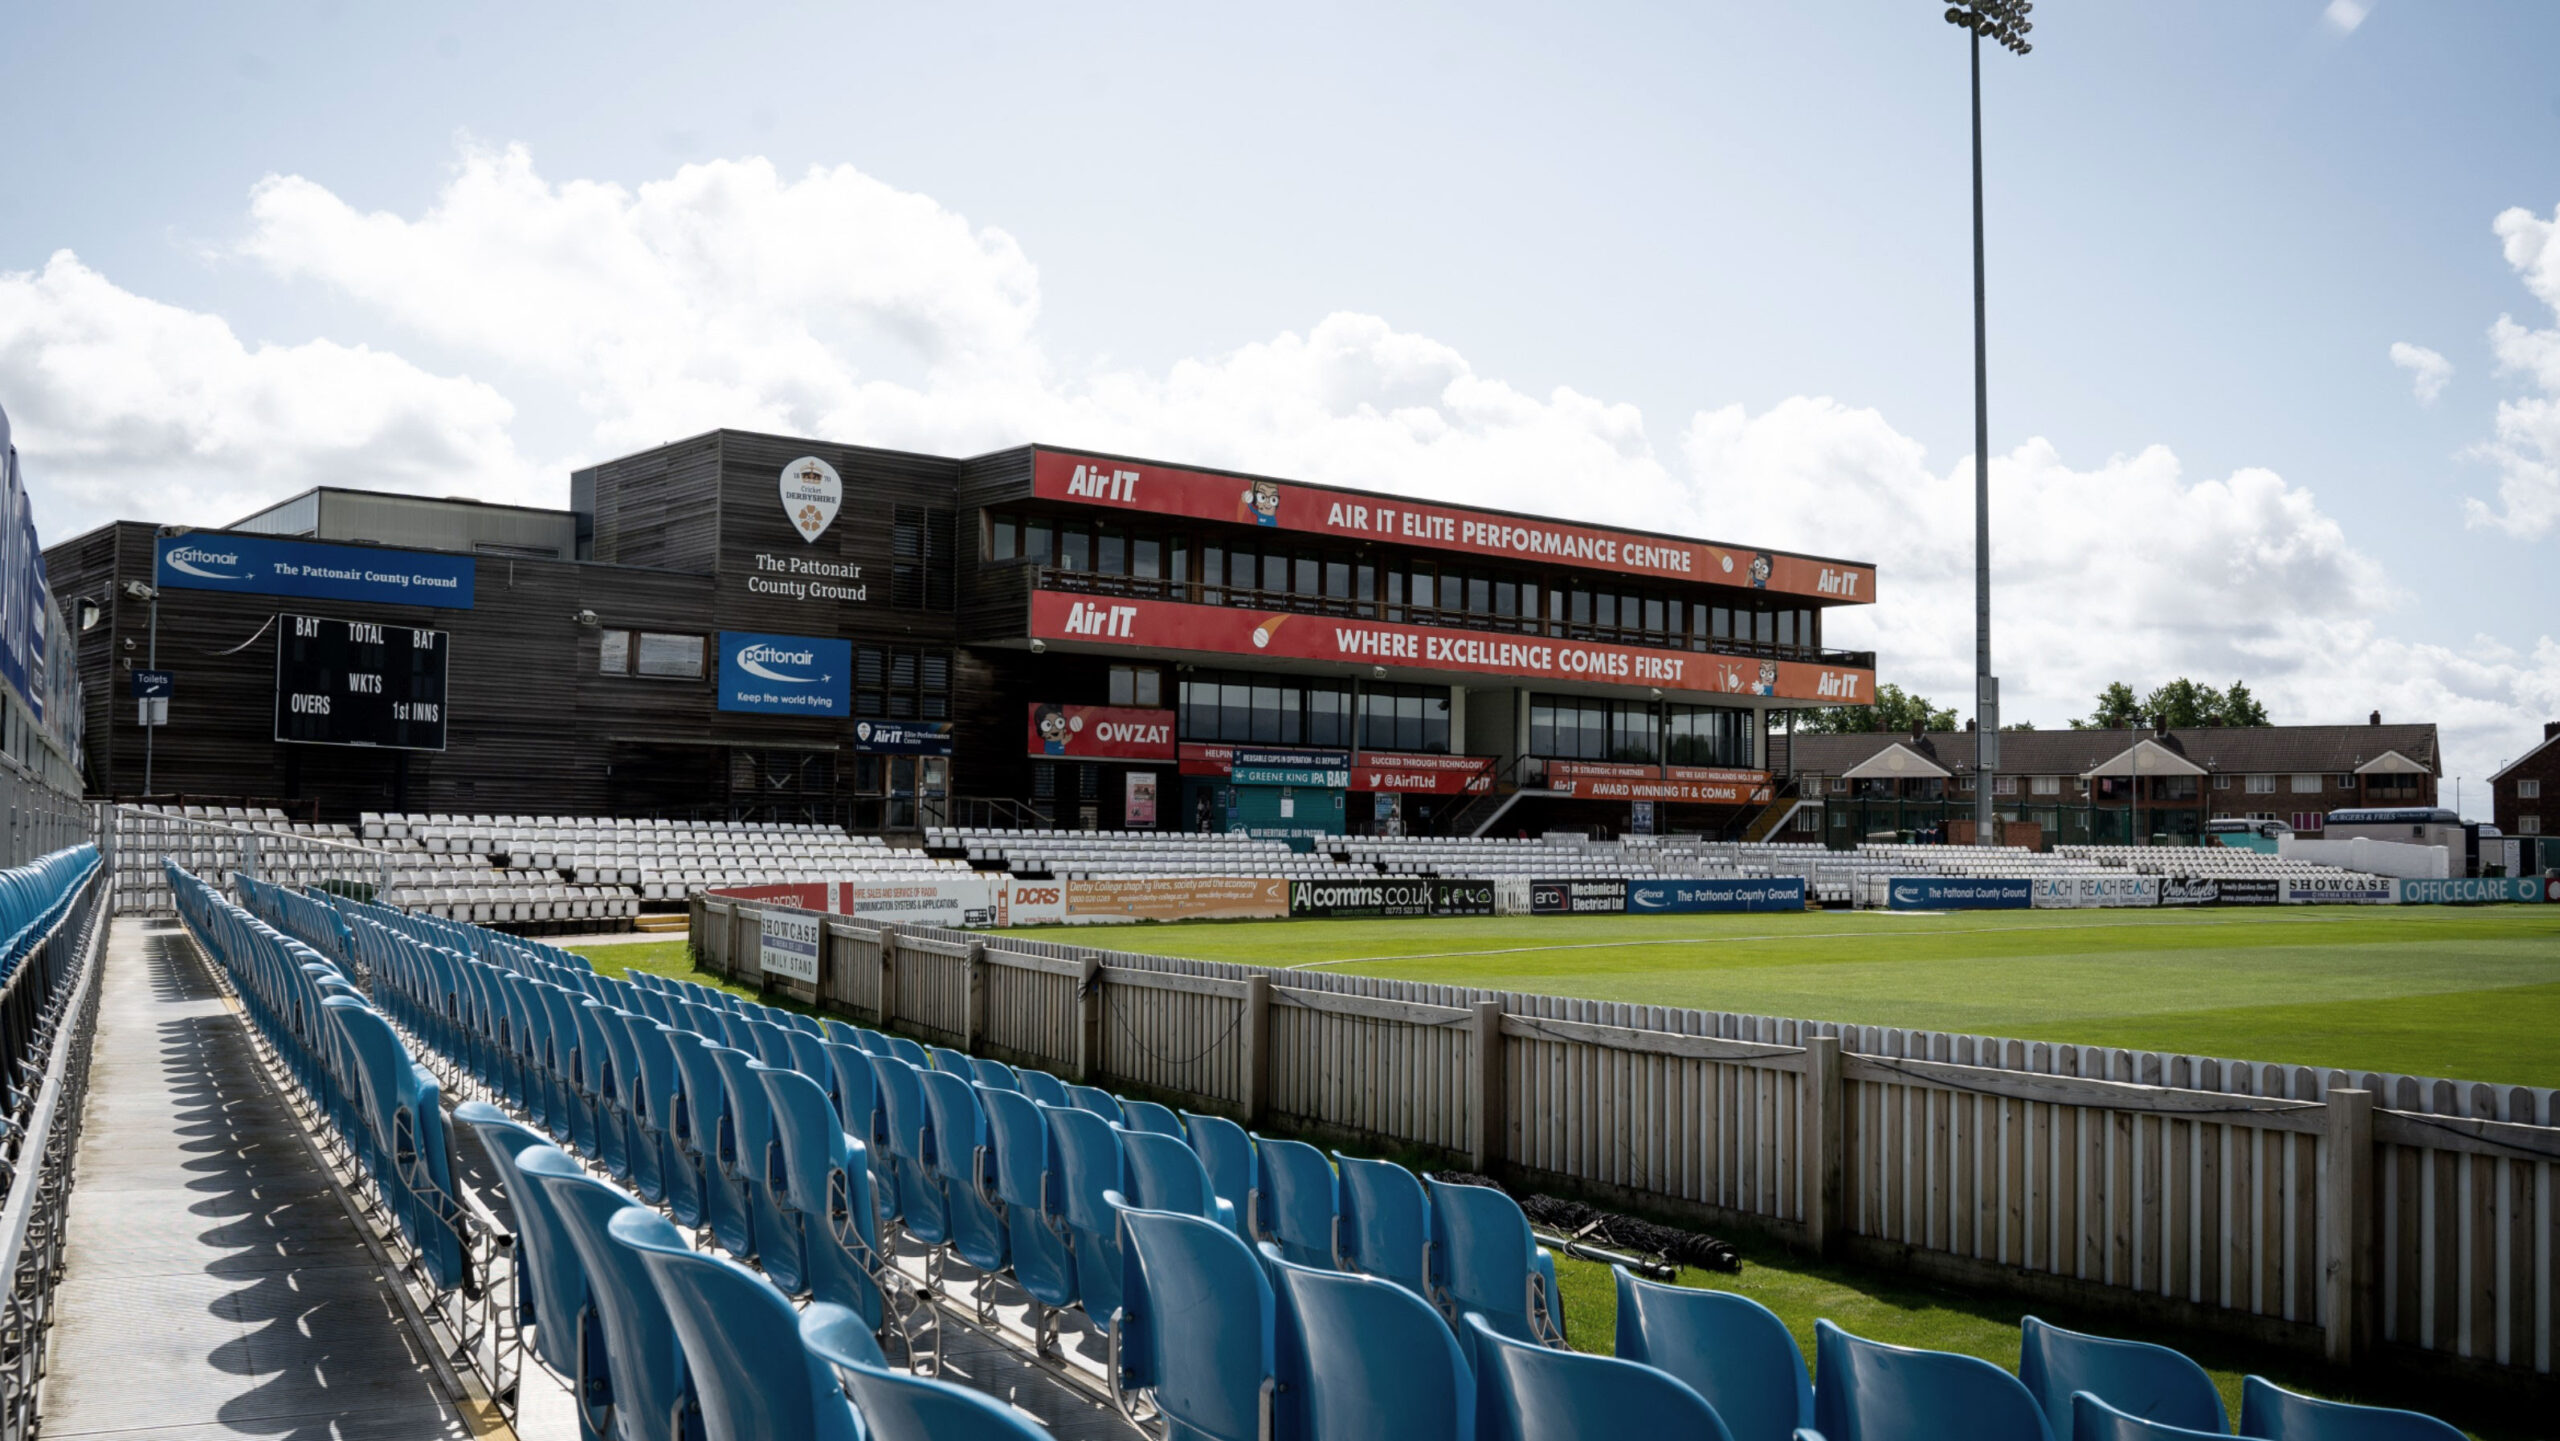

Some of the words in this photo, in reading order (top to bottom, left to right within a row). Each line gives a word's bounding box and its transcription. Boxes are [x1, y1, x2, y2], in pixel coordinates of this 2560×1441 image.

[786, 491, 837, 504] DERBYSHIRE
[801, 485, 822, 494] Cricket
[1327, 502, 1369, 531] AIR
[1376, 508, 1396, 533] IT
[1403, 512, 1455, 542] ELITE
[1462, 520, 1616, 564] PERFORMANCE
[1622, 543, 1692, 574] CENTRE
[172, 549, 239, 566] pattonair
[756, 554, 786, 572] The
[790, 557, 862, 578] Pattonair
[274, 562, 299, 576] The
[302, 566, 361, 582] Pattonair
[364, 570, 410, 588] County
[412, 574, 458, 588] Ground
[748, 576, 806, 600] County
[810, 582, 867, 601] Ground
[296, 616, 320, 638] BAT
[349, 622, 385, 645] TOTAL
[412, 630, 435, 650] BAT
[744, 647, 814, 666] pattonair
[1335, 628, 1419, 660] WHERE
[1426, 636, 1553, 671] EXCELLENCE
[1558, 648, 1629, 678] COMES
[1634, 656, 1684, 682] FIRST
[138, 674, 168, 684] Toilets
[348, 672, 383, 695] WKTS
[291, 693, 331, 716] OVERS
[392, 700, 410, 721] 1st
[412, 702, 440, 723] INNS
[738, 692, 761, 704] Keep
[763, 692, 779, 703] the
[780, 694, 806, 705] world
[808, 695, 832, 708] flying
[917, 732, 950, 740] Performance
[1096, 722, 1170, 744] OWZAT
[1205, 749, 1233, 758] HELPIN
[1243, 754, 1267, 762] REUSABLE
[1268, 754, 1280, 763] CUPS
[1322, 757, 1341, 765] DEPOSIT
[1371, 756, 1401, 766] SUCCEED
[1403, 758, 1438, 768] THROUGH
[1439, 759, 1484, 769] TECHNOLOGY
[1248, 772, 1284, 782] GREENE
[1286, 773, 1308, 782] KING
[1311, 773, 1325, 784] IPA
[1326, 770, 1348, 787] BAR
[1580, 766, 1610, 775] STRATEGIC
[1618, 768, 1644, 777] PARTNER
[1694, 772, 1706, 780] EAST
[1708, 772, 1738, 781] MIDLANDS
[1384, 774, 1436, 788] @AirITLtd
[1592, 783, 1629, 796] AWARD
[1632, 784, 1678, 798] WINNING
[1682, 786, 1690, 798] IT
[1691, 787, 1698, 798] &
[1701, 787, 1737, 800] COMMS
[2330, 814, 2366, 822] BURGERS
[868, 888, 881, 898] SALES
[882, 888, 892, 898] AND
[894, 887, 913, 898] SERVICE
[914, 887, 920, 897] OF
[921, 887, 937, 897] RADIO
[1070, 880, 1093, 893] Derby
[1095, 880, 1122, 894] College
[1124, 880, 1151, 893] shaping
[1174, 880, 1197, 891] society
[1198, 879, 1212, 890] and
[1213, 879, 1224, 889] the
[1225, 880, 1258, 890] economy
[1571, 883, 1619, 896] Mechanical
[1620, 885, 1626, 895] &
[2034, 879, 2072, 896] REACH
[2080, 880, 2116, 896] REACH
[2120, 880, 2156, 896] REACH
[2161, 878, 2186, 897] Owen
[2185, 877, 2218, 902] Taylor
[2289, 880, 2390, 890] SHOWCASE
[2406, 880, 2509, 902] OFFICECARE
[1015, 887, 1060, 904] DCRS
[1535, 891, 1560, 904] arc
[1678, 890, 1692, 902] The
[1695, 889, 1734, 901] Pattonair
[1736, 888, 1766, 903] County
[1768, 888, 1798, 900] Ground
[1928, 888, 1941, 898] The
[1943, 888, 1974, 898] Pattonair
[1976, 888, 2000, 900] County
[2002, 887, 2027, 898] Ground
[855, 900, 893, 912] COMMUNICATION
[894, 900, 916, 911] SYSTEMS
[922, 899, 958, 910] APPLICATIONS
[1573, 898, 1610, 912] Electrical
[1612, 897, 1624, 910] Ltd
[763, 918, 817, 943] SHOWCASE
[772, 939, 788, 949] CINEMA
[764, 951, 788, 968] FAMILY
[791, 957, 812, 975] STAND
